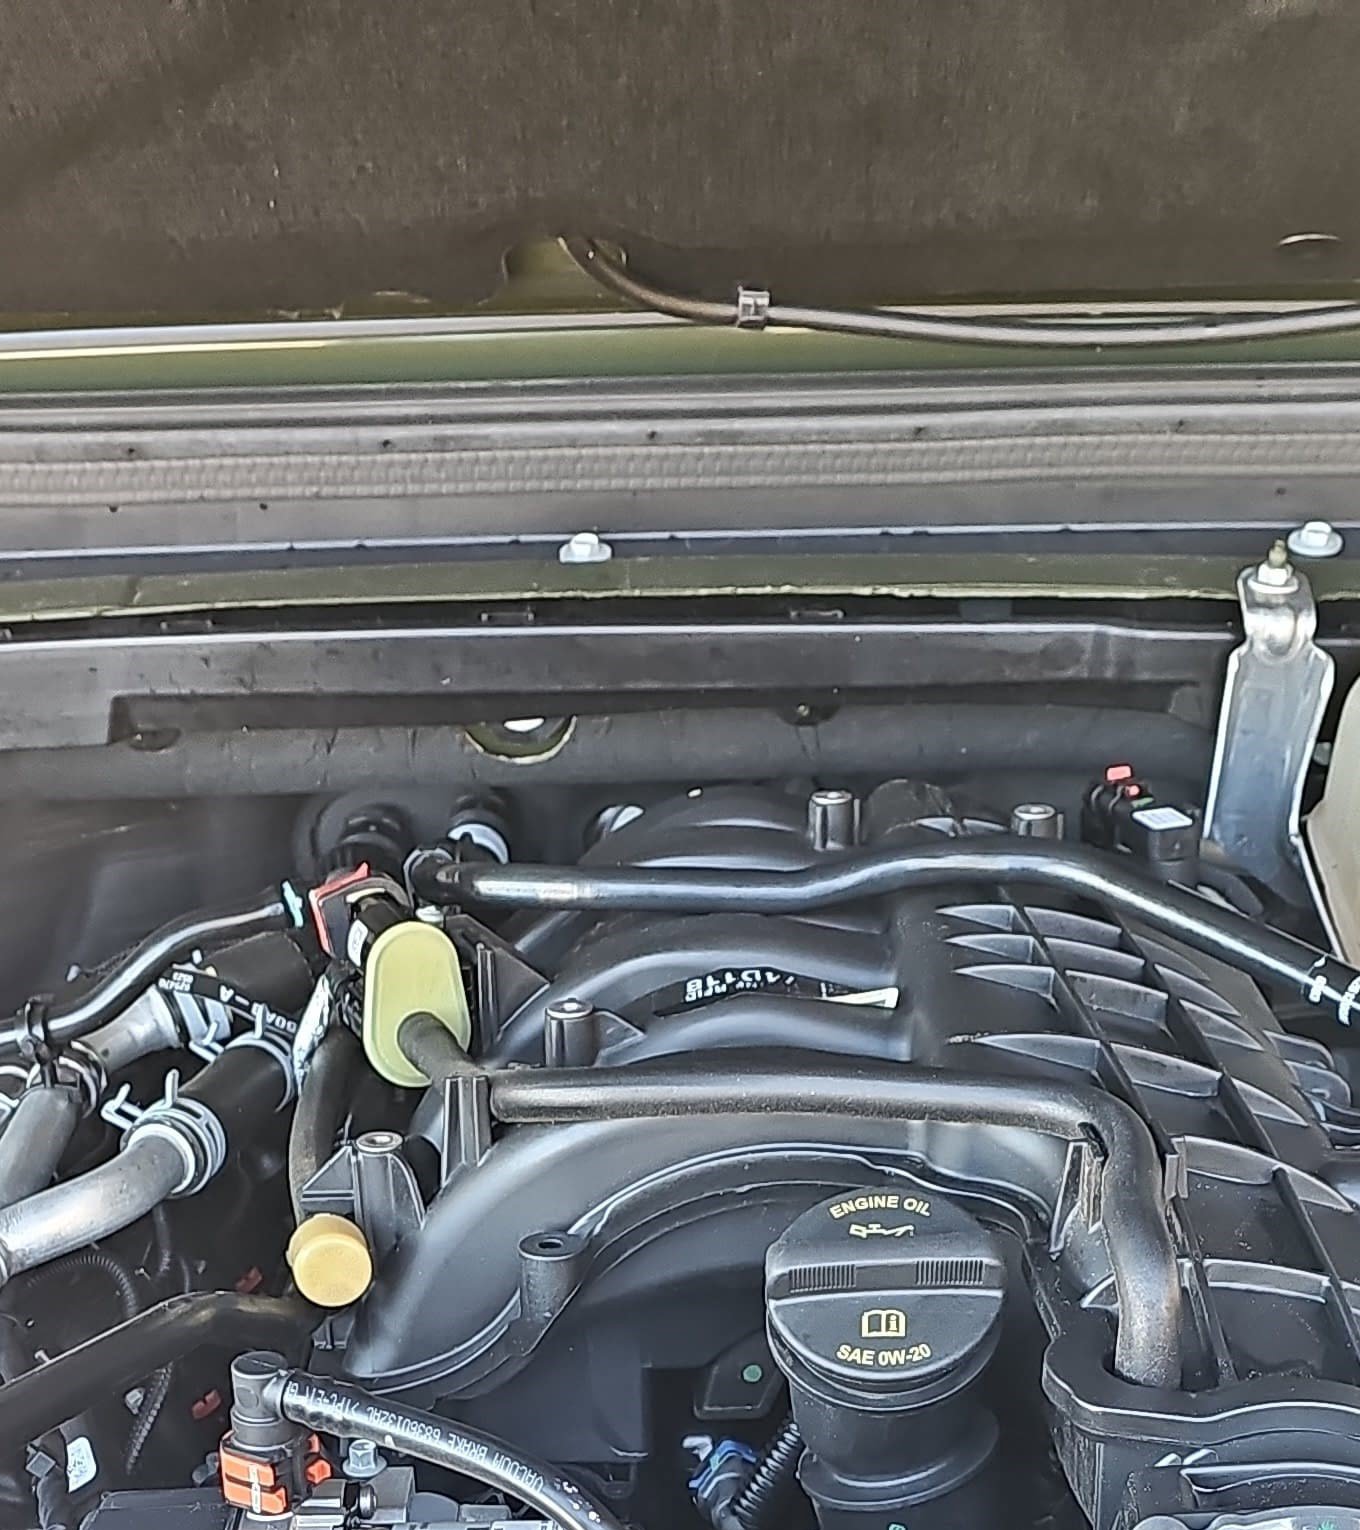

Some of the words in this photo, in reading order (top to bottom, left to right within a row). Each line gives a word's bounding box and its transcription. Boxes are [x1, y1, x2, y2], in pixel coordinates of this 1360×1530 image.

[829, 1194, 899, 1219] ENGINE
[903, 1197, 932, 1217] OIL
[836, 1344, 875, 1366] SAE
[878, 1343, 932, 1366] 0W-20
[447, 1432, 488, 1462] BRAKE
[493, 1456, 544, 1494] VACUUM
